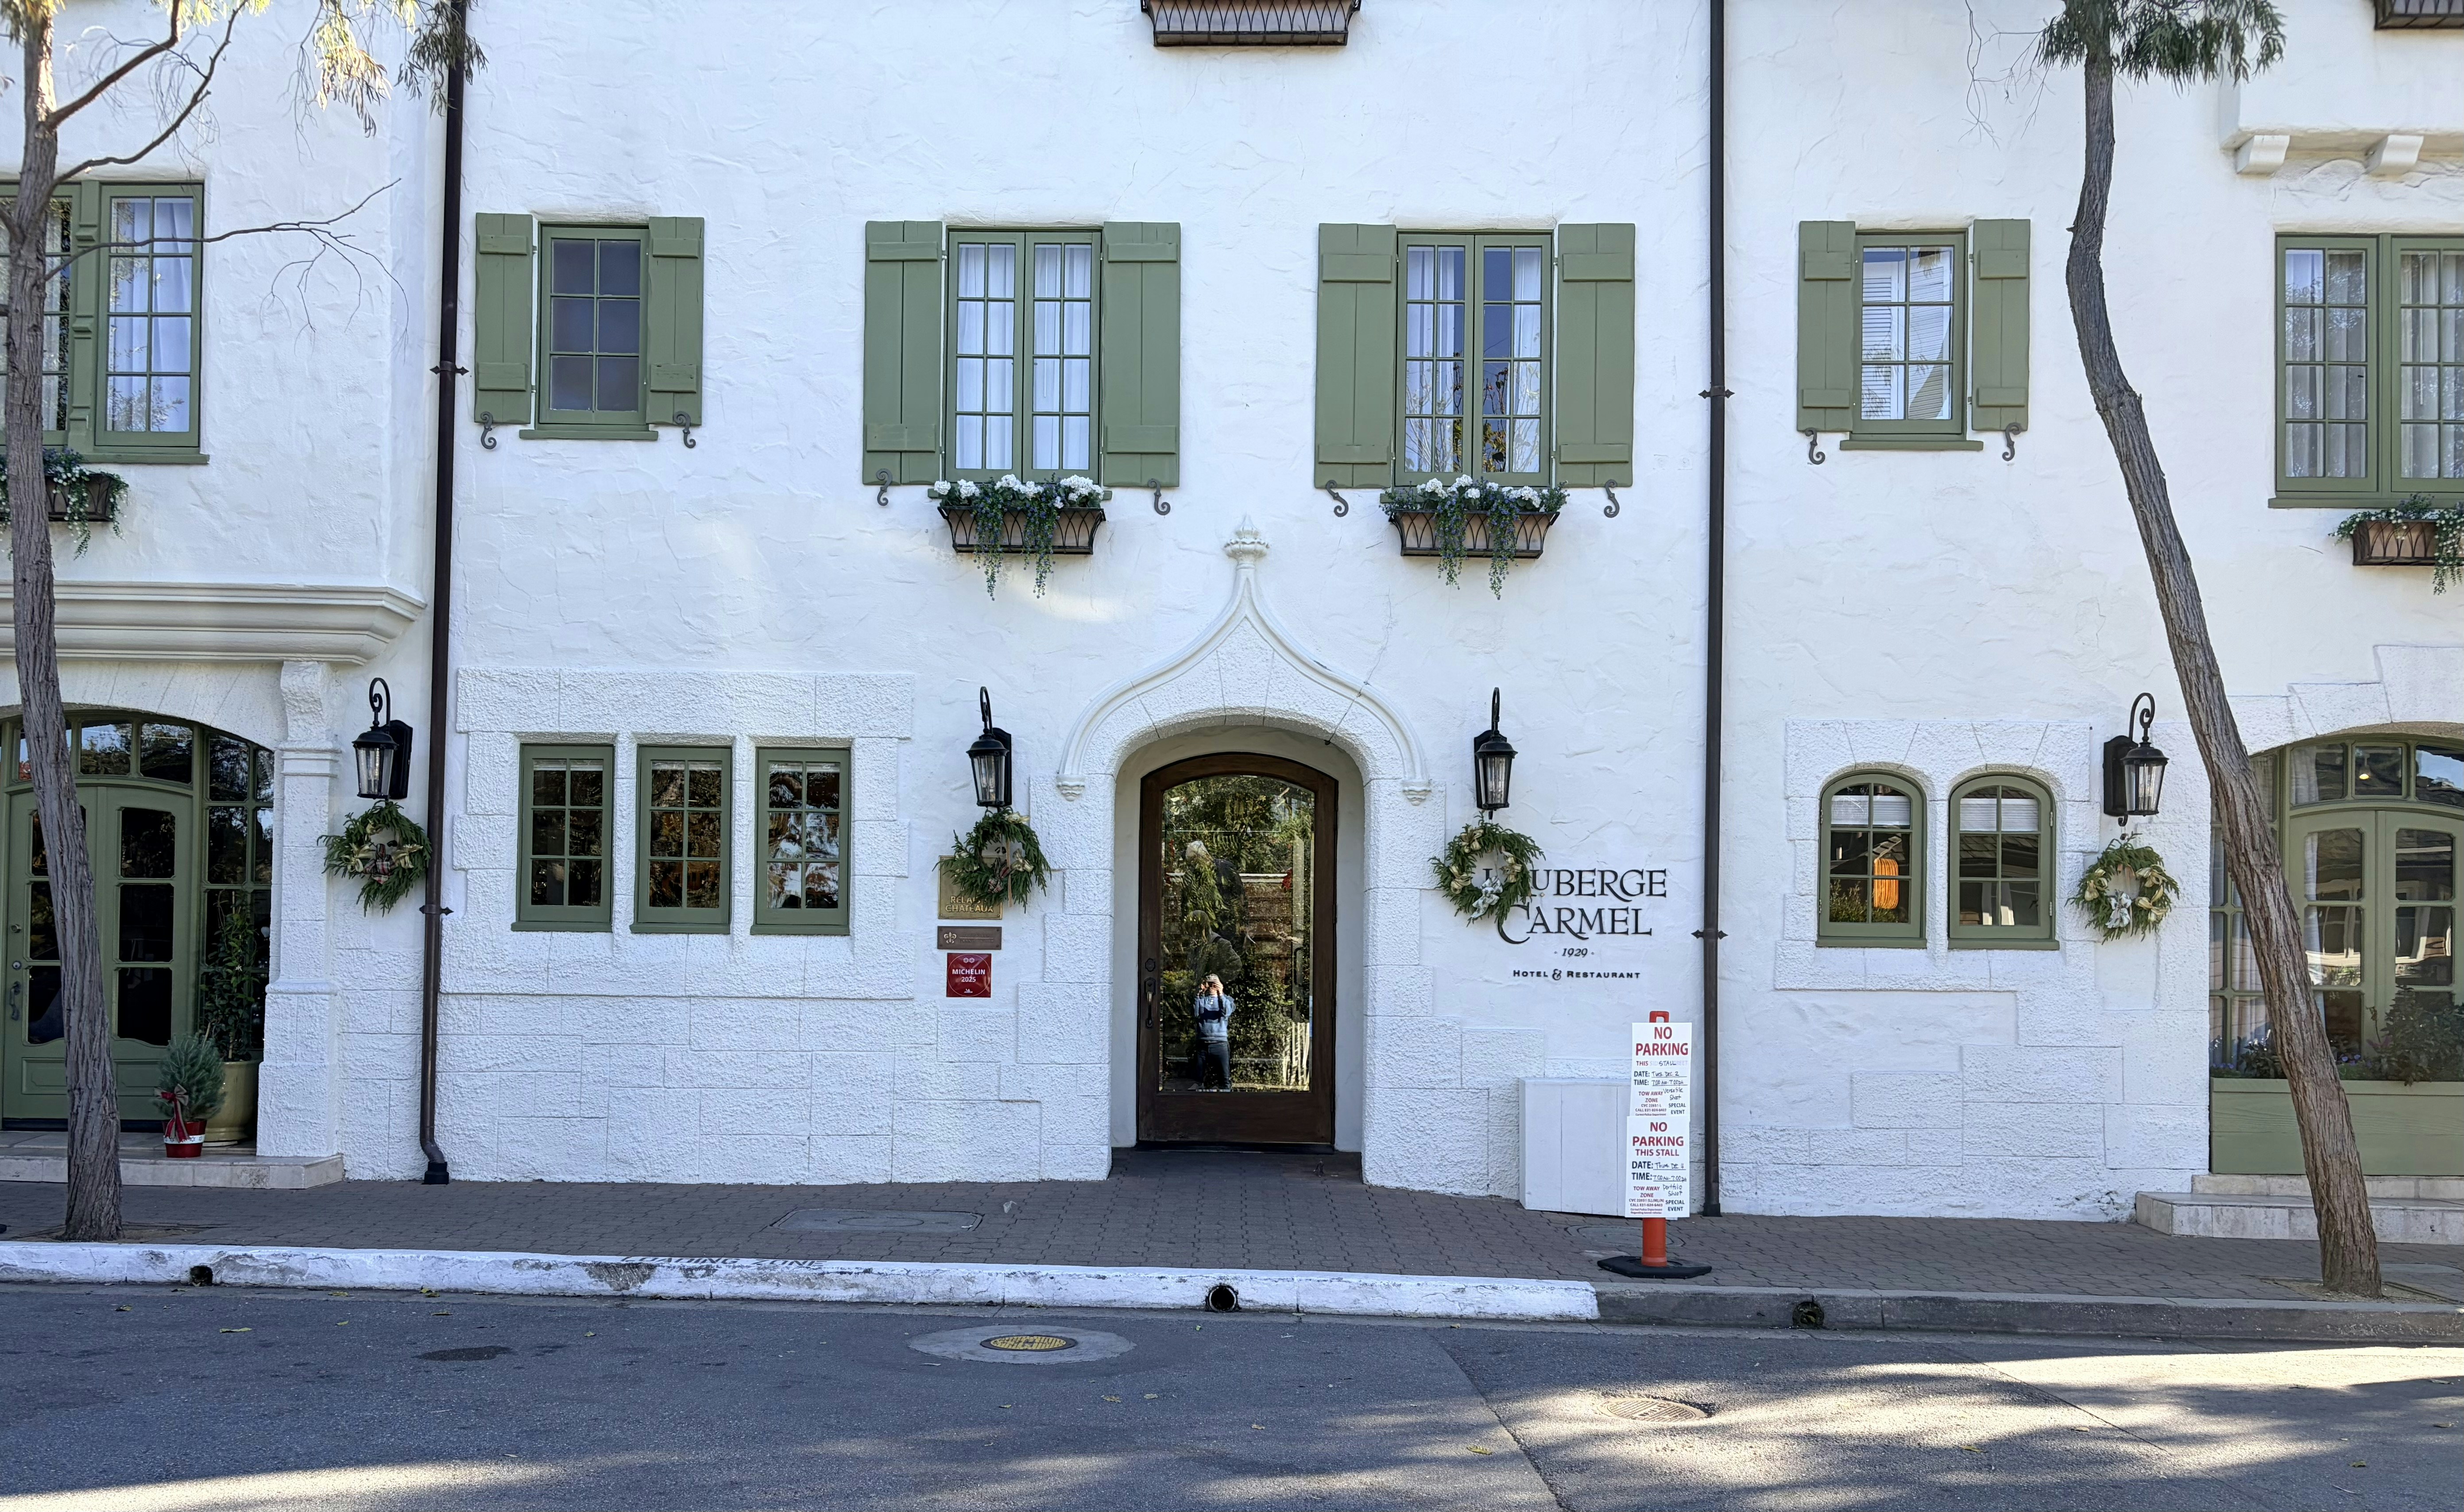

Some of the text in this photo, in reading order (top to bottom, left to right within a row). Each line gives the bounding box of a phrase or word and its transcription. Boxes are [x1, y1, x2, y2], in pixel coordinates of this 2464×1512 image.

[1483, 868, 1667, 902] UBERGE
[1497, 901, 1652, 945] CARMEL
[1562, 947, 1588, 958] 1929
[1552, 969, 1562, 981] &
[1567, 971, 1641, 979] RESTAURANT
[1654, 1026, 1672, 1040] NO
[1636, 1043, 1688, 1056] PARKING
[1650, 1122, 1667, 1132] NO
[1632, 1136, 1684, 1146] PARKING
